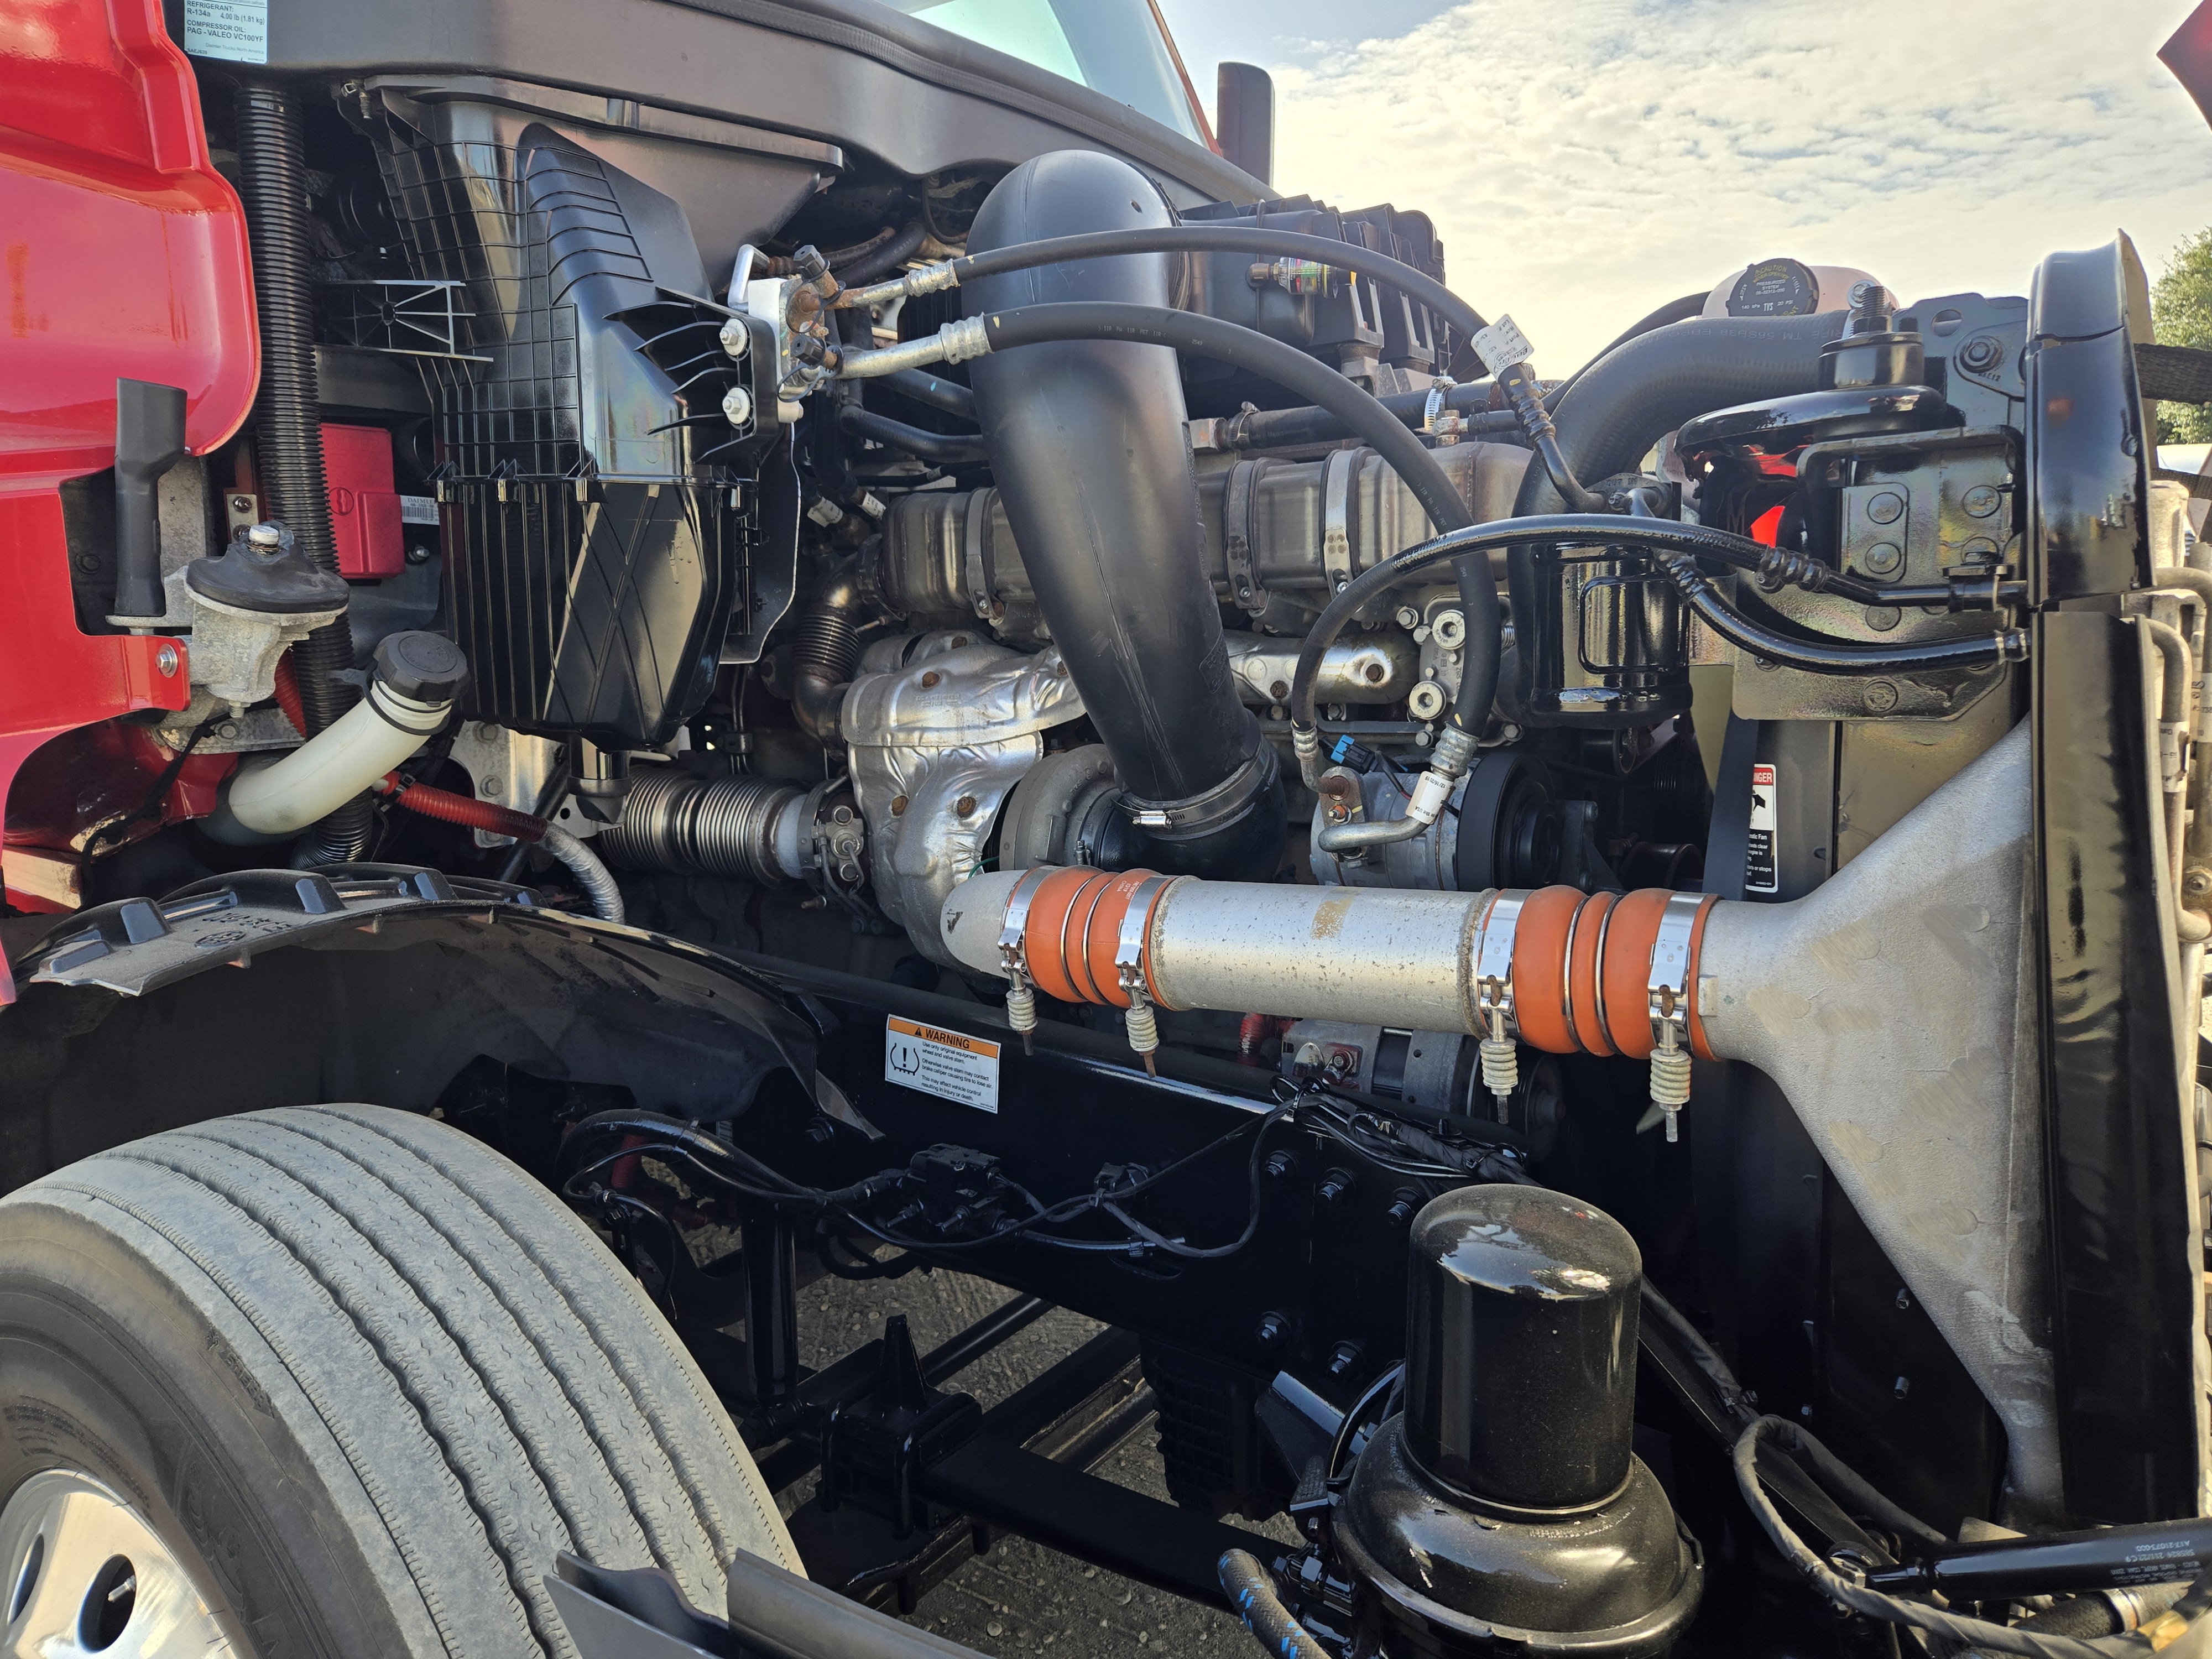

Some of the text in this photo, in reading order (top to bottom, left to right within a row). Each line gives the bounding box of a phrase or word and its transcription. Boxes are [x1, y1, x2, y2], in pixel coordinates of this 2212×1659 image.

[187, 1, 234, 12] REFRIGERANT:
[187, 8, 211, 17] R-134a
[241, 14, 254, 23] (1.81
[256, 17, 265, 25] kg)
[187, 19, 233, 31] COMPRESSOR
[187, 27, 202, 35] PAG
[207, 29, 232, 39] VALEO
[233, 33, 263, 42] VC100YF
[1761, 265, 1787, 273] CAUTION
[1764, 302, 1773, 311] TVS
[926, 1029, 970, 1049] WARNING
[956, 1052, 978, 1060] equipment
[922, 1058, 942, 1068] Otherwise
[947, 1072, 963, 1082] causing
[921, 1082, 938, 1092] resulting
[943, 1088, 955, 1096] injury
[952, 1084, 966, 1092] vehicle
